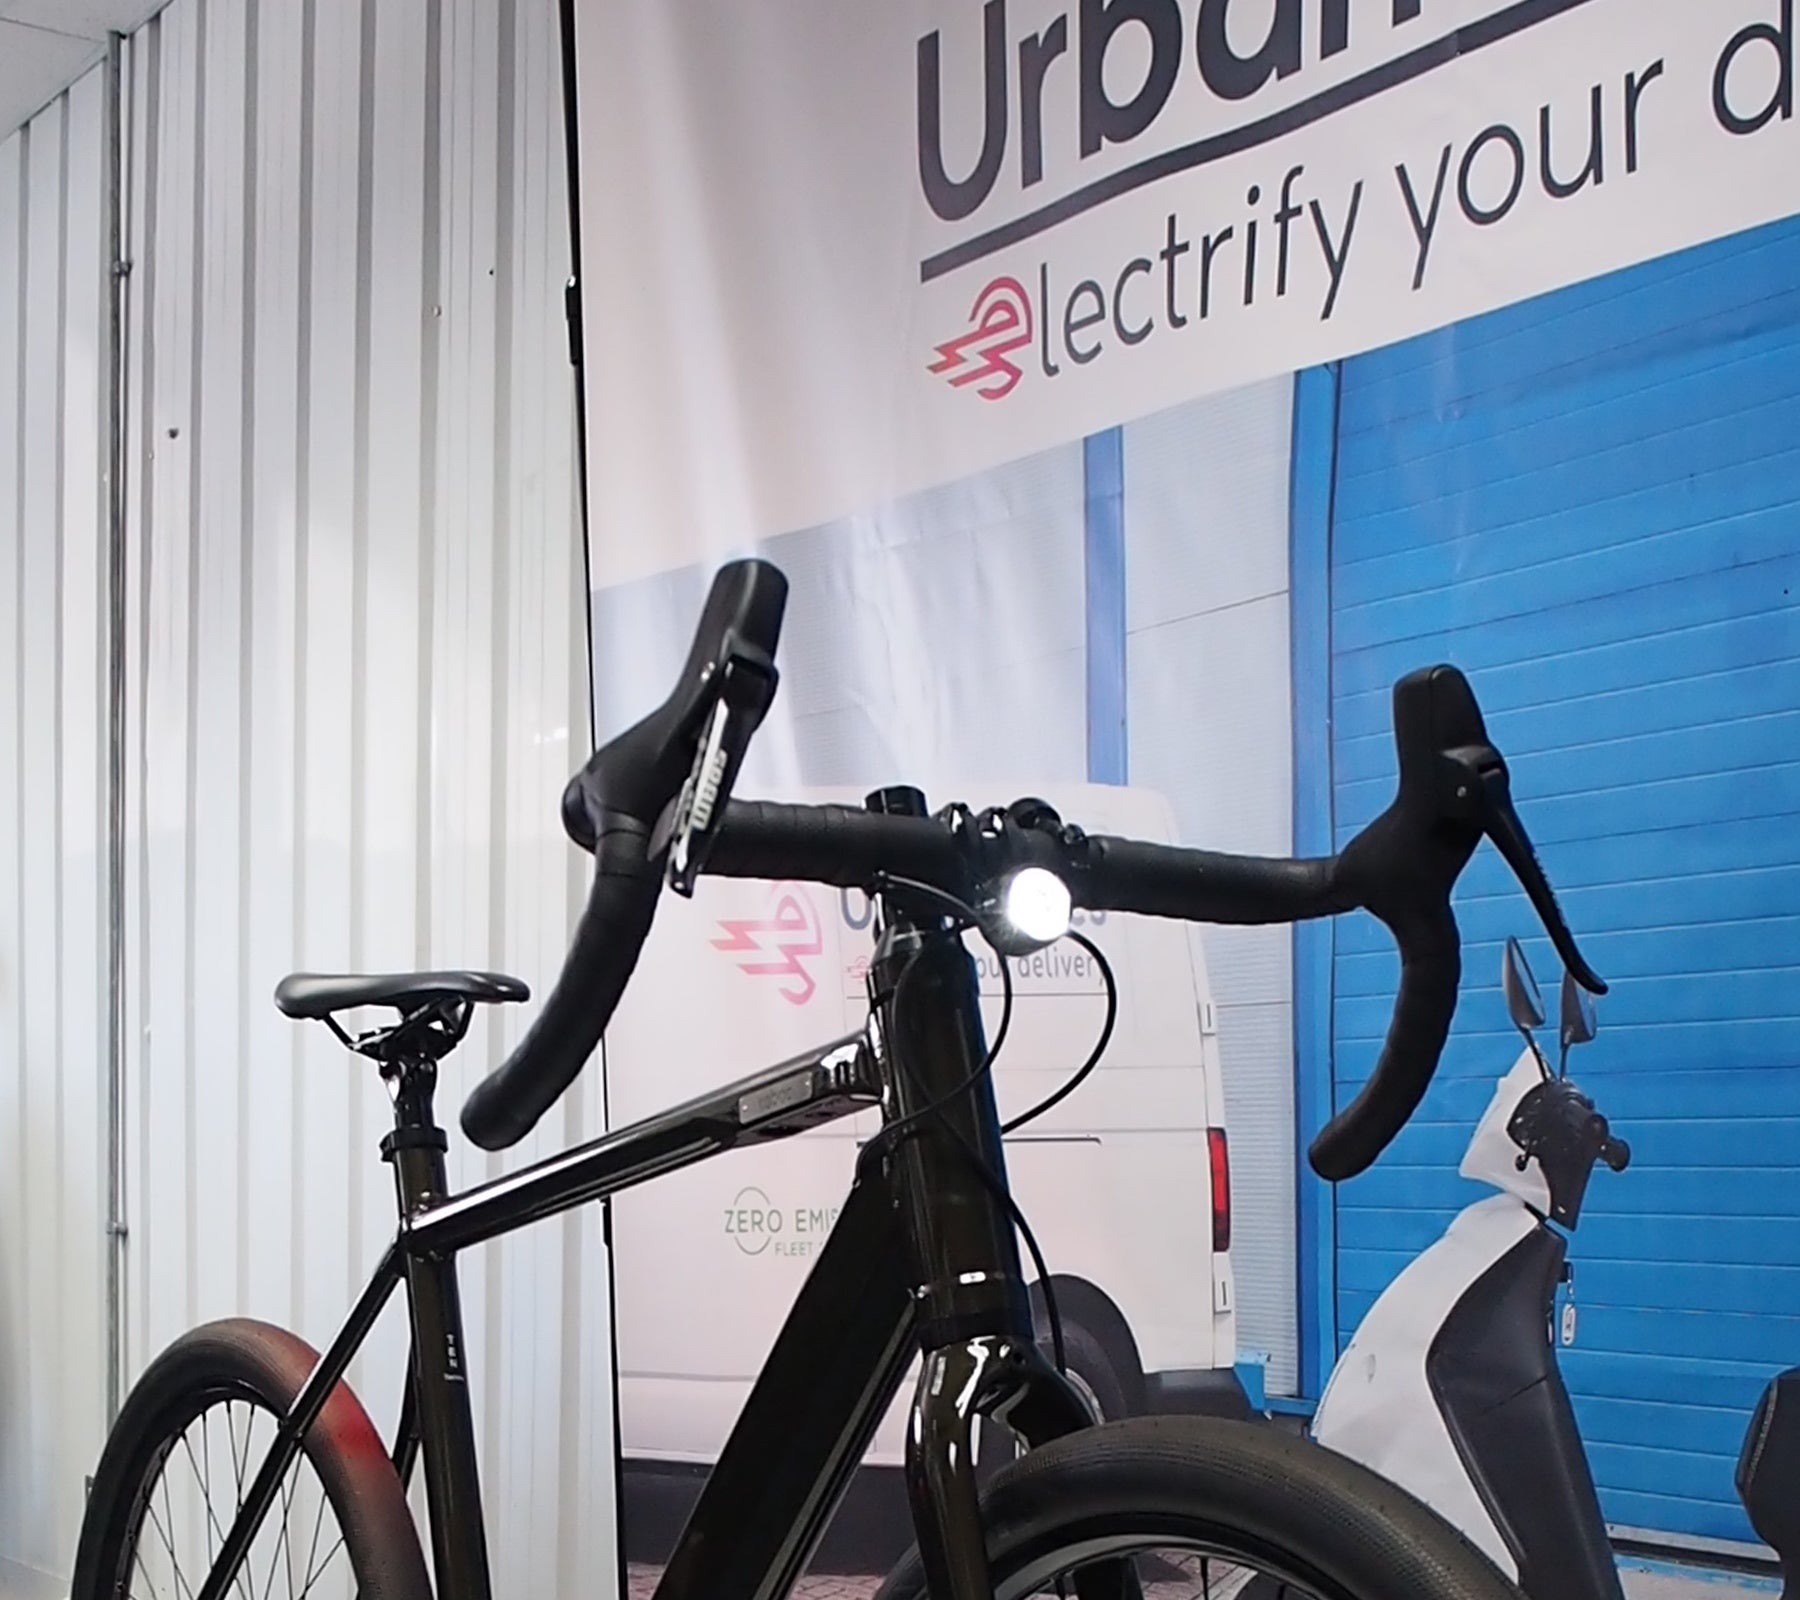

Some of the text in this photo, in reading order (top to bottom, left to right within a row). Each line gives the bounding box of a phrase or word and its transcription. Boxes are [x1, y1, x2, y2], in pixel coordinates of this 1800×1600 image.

[1395, 58, 1664, 291] your
[1018, 945, 1104, 988] deliver
[724, 1208, 783, 1233] ZERO
[775, 1241, 814, 1256] FLEET
